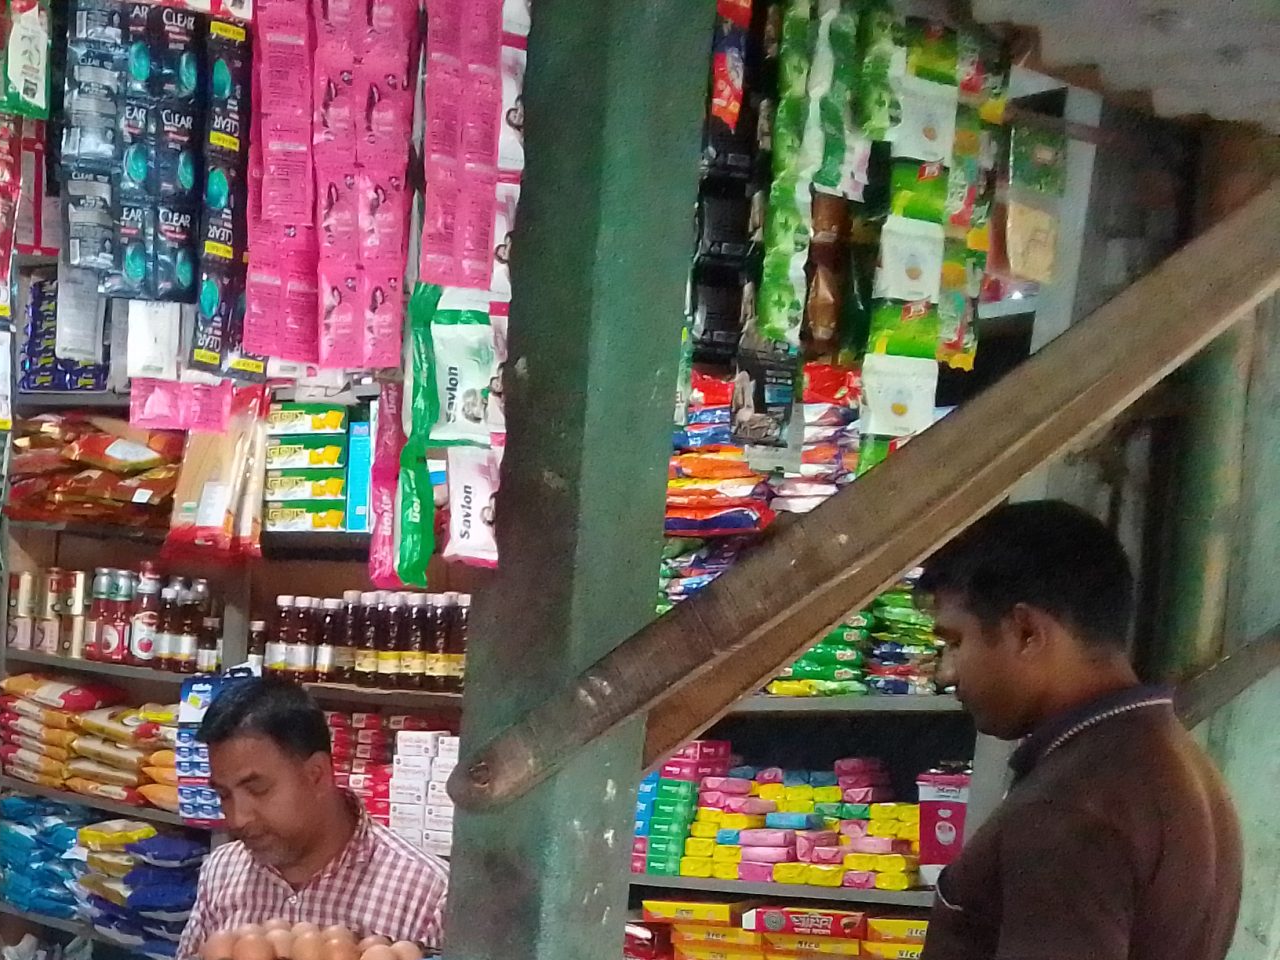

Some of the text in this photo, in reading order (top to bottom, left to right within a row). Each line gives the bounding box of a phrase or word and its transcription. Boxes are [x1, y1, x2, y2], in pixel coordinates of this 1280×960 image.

[162, 8, 196, 30] CLEAR
[161, 109, 193, 130] CLEAR
[214, 115, 240, 137] CLEAR
[159, 208, 191, 229] CLEAR
[207, 225, 233, 246] CLEAR
[446, 366, 459, 424] Savlon
[460, 485, 473, 540] Savlon
